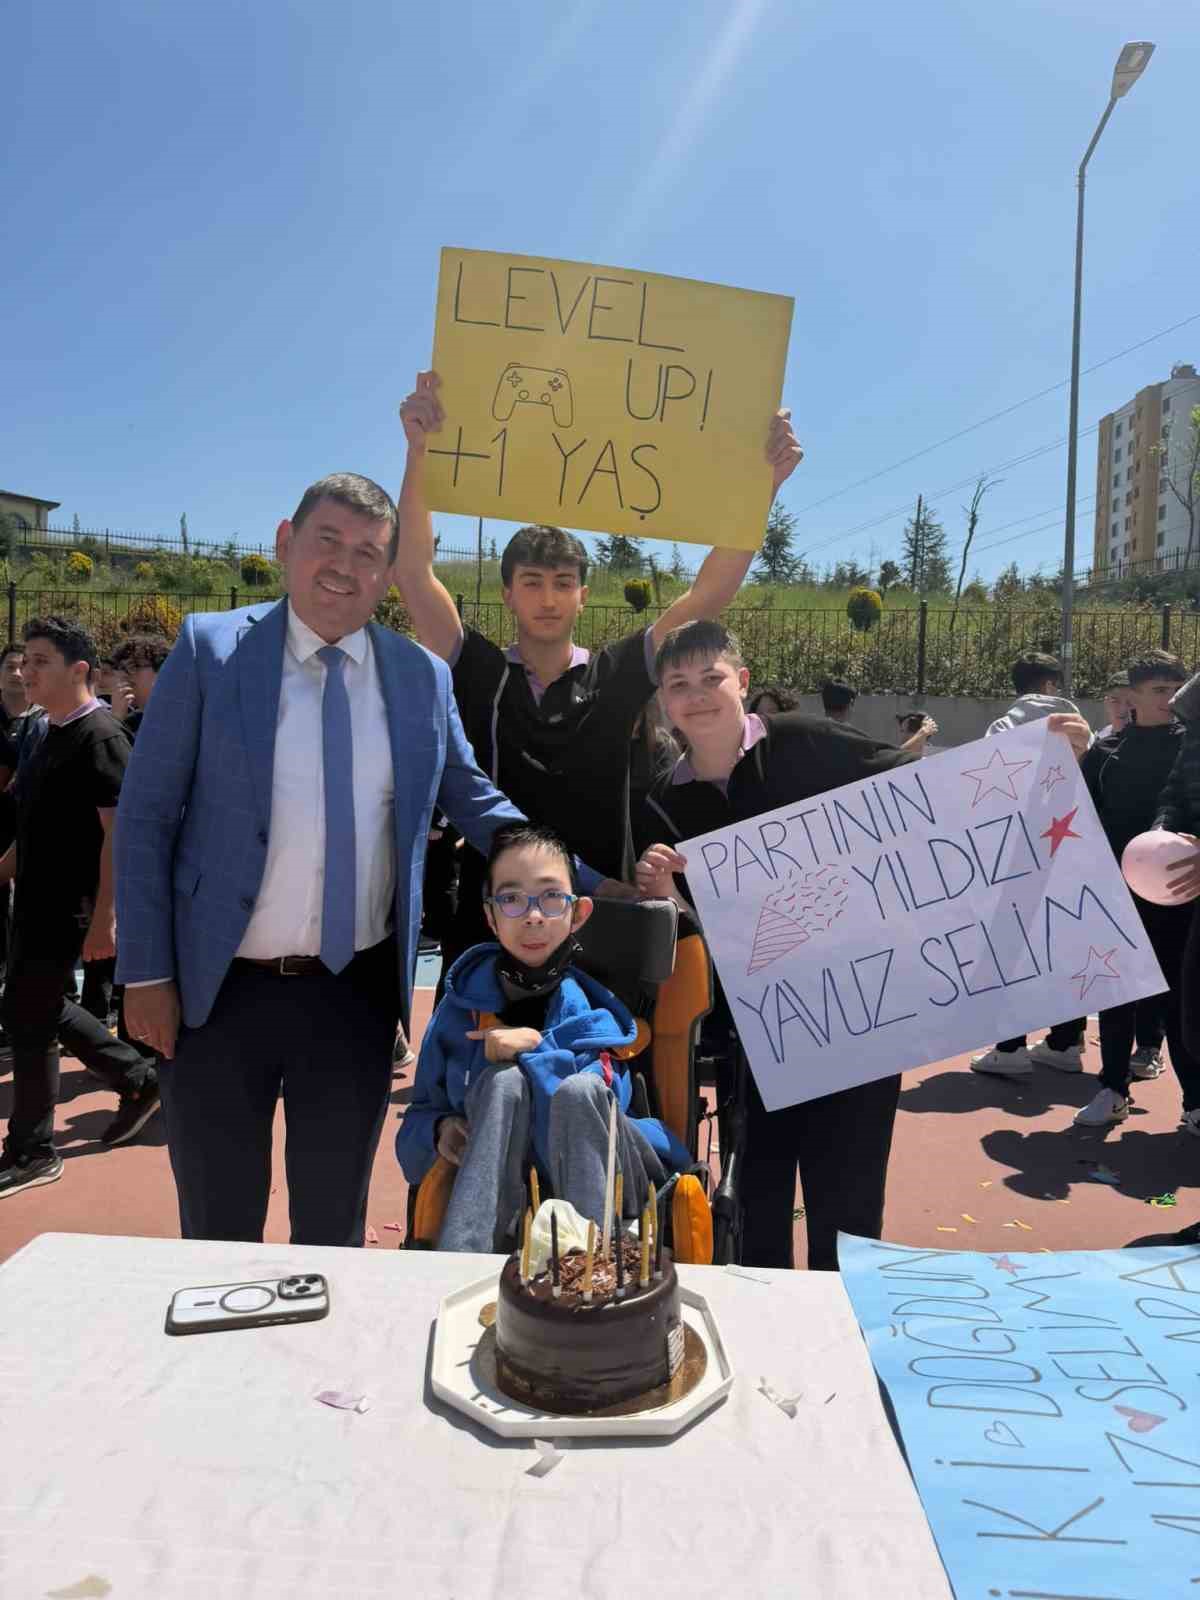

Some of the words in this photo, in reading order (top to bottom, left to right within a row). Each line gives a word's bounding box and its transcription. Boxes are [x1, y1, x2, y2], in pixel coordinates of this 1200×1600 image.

[453, 261, 686, 353] LEVEL
[625, 358, 713, 432] UP!
[426, 426, 508, 497] +1
[551, 432, 662, 521] YAŞ
[700, 773, 937, 899] PARTİNİN
[851, 810, 1042, 921] YILDIZI
[736, 948, 919, 1065] YAVUZ
[919, 883, 1139, 1008] SELİM
[1005, 1271, 1188, 1412] SELİM
